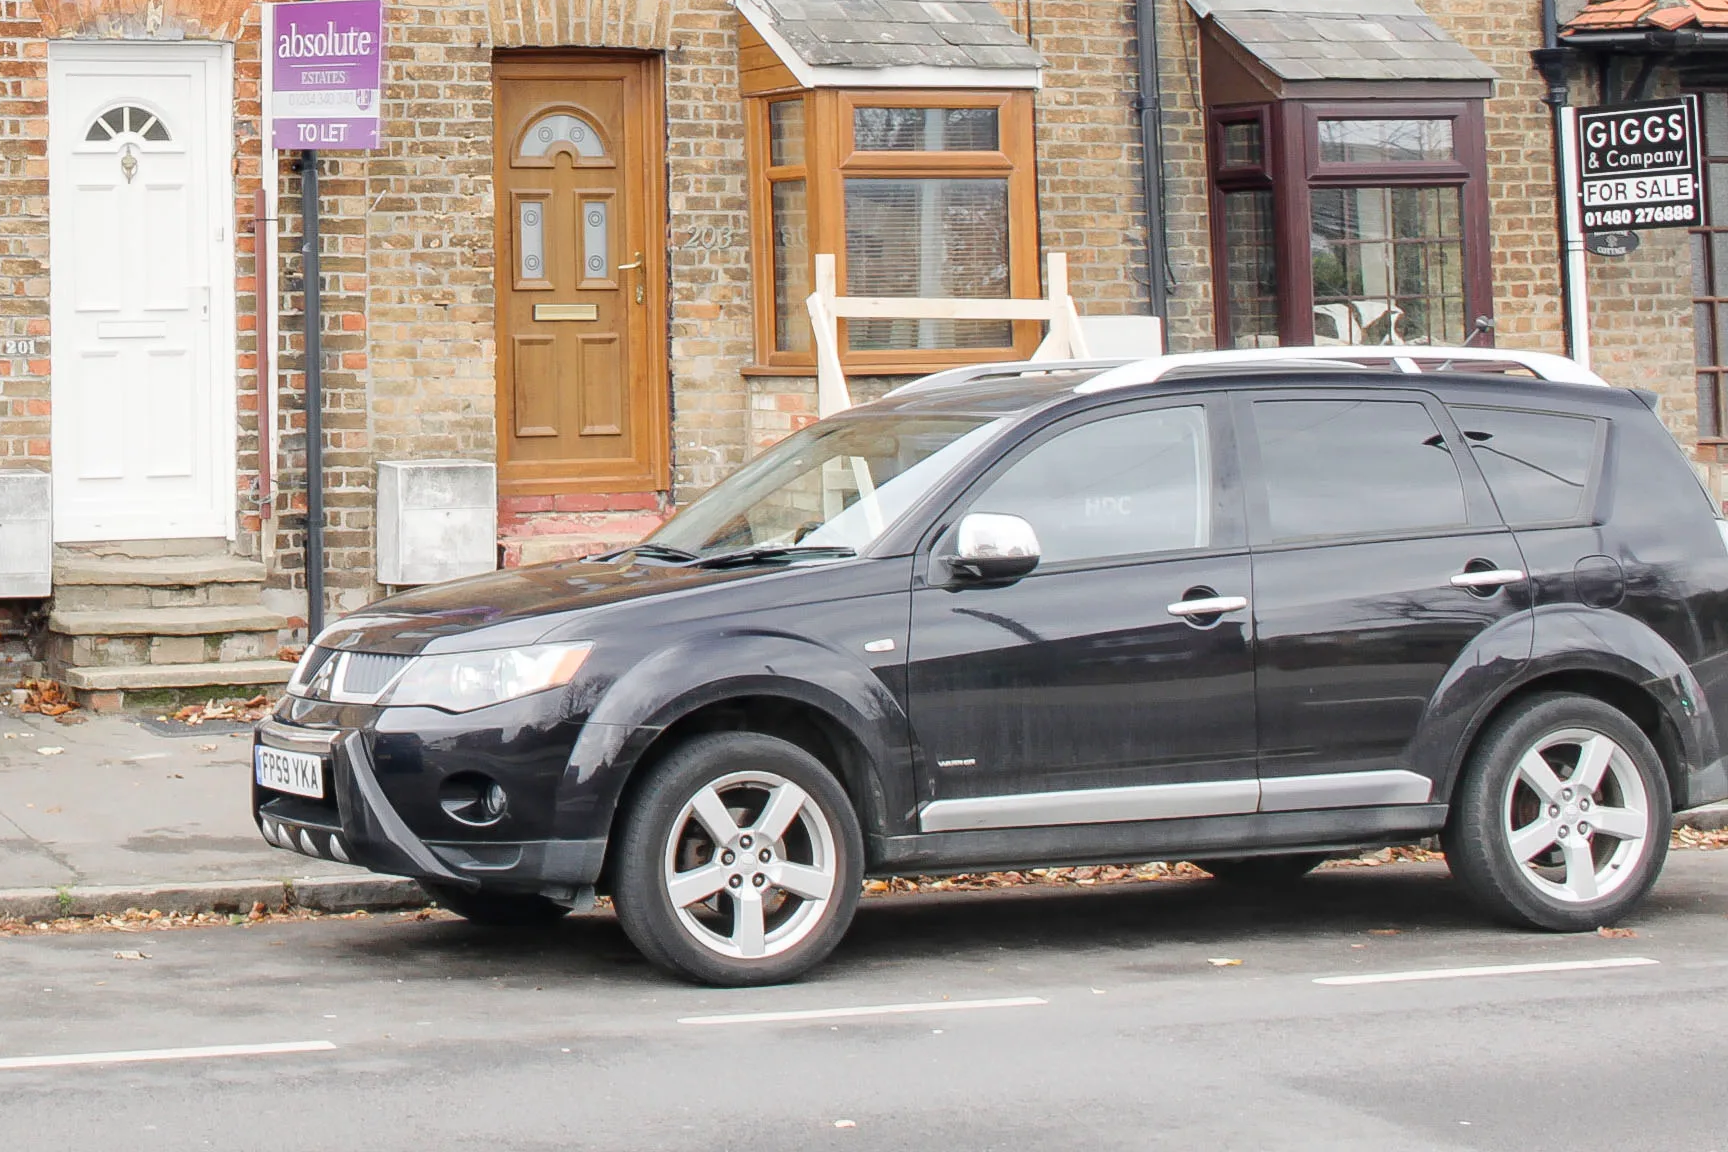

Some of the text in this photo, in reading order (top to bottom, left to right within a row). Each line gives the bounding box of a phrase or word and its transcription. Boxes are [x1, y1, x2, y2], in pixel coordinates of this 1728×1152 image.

[278, 21, 372, 58] absolute
[301, 70, 346, 85] ESTATES
[297, 123, 348, 142] TO LET
[1586, 113, 1684, 148] GIGGS
[1588, 149, 1684, 169] & Company
[1587, 177, 1690, 203] FOR SALE
[1584, 204, 1694, 227] 01480 276888
[5, 339, 36, 355] 201
[262, 751, 319, 790] FP59 YKA
